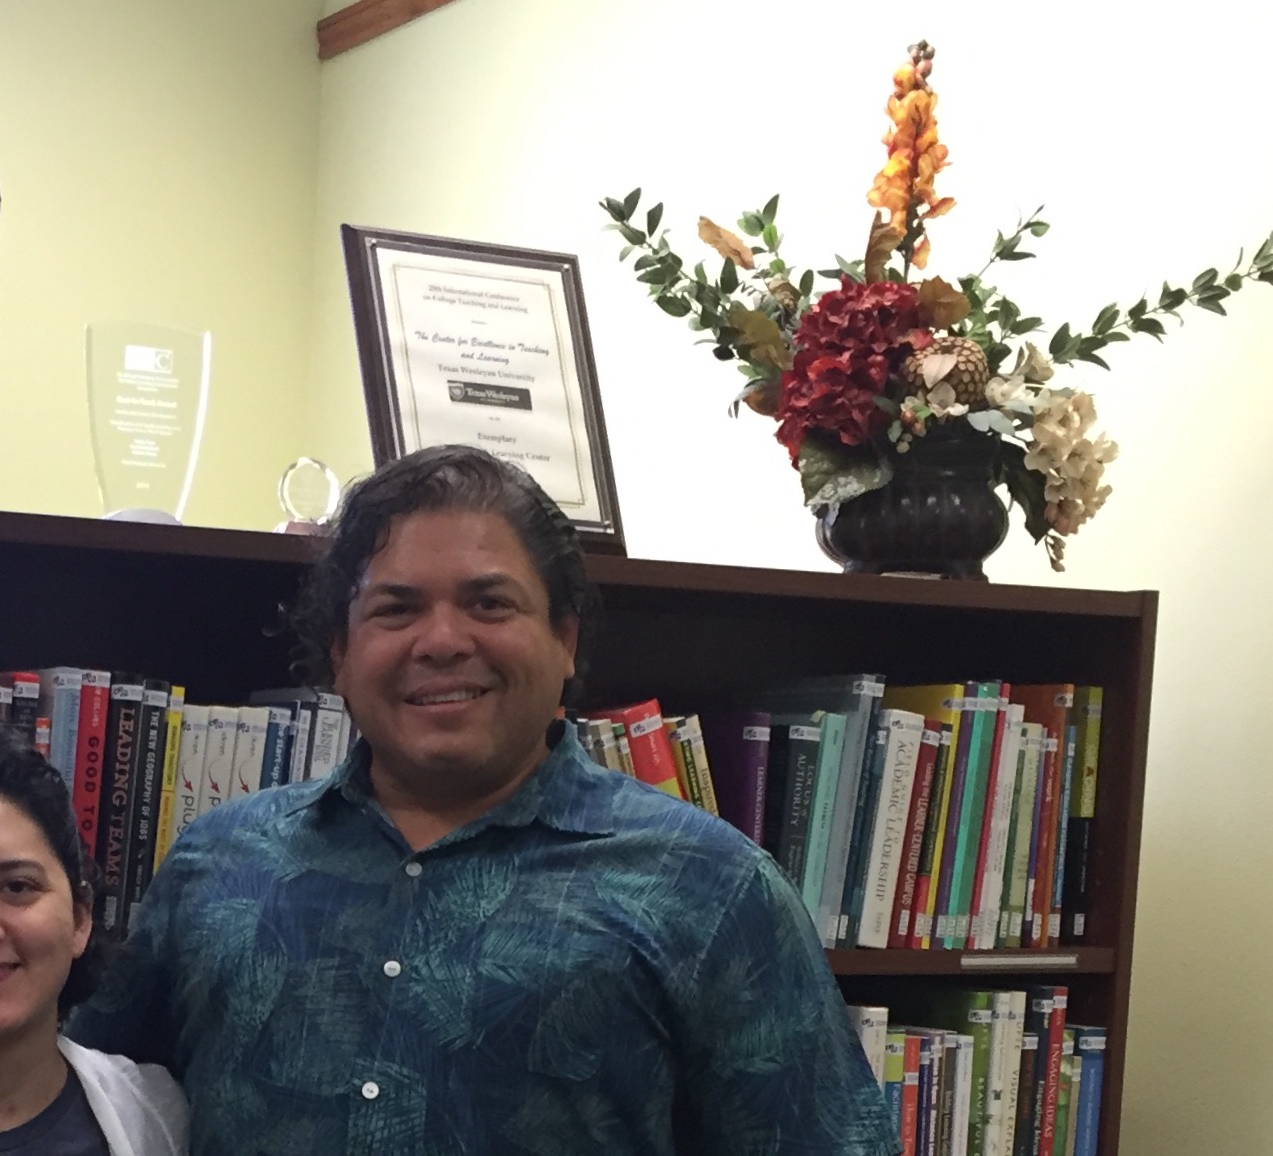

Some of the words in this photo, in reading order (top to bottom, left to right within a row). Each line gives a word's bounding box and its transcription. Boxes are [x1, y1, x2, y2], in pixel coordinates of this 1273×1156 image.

[415, 330, 429, 341] The
[431, 332, 456, 344] Center
[517, 342, 550, 357] Teaching
[461, 352, 475, 360] and
[477, 352, 510, 365] Learning
[438, 363, 459, 374] Texas
[460, 365, 497, 378] Wesleyan
[498, 370, 535, 384] University
[147, 729, 159, 750] NEW
[149, 711, 161, 727] THE
[84, 736, 100, 793] GOOD
[111, 707, 136, 807] LEADING
[142, 751, 156, 803] GEOGRAPHY
[271, 738, 284, 780] start-up
[888, 739, 908, 813] ACADEMIC
[790, 753, 807, 828] AUTHORITY
[82, 805, 96, 831] TO
[139, 819, 149, 840] JOBS
[103, 811, 126, 887] TEAMS
[875, 817, 896, 902] LEADERSHIP
[901, 873, 916, 906] CAMPUS
[1007, 1069, 1019, 1110] VISUAL
[1045, 1042, 1061, 1104] ENGAGING
[906, 1103, 914, 1122] How
[972, 1077, 986, 1145] BEAUTIFUL
[1033, 1079, 1046, 1127] Engaging
[1043, 1105, 1056, 1138] IDEAS
[1031, 1129, 1043, 1156] Ideas
